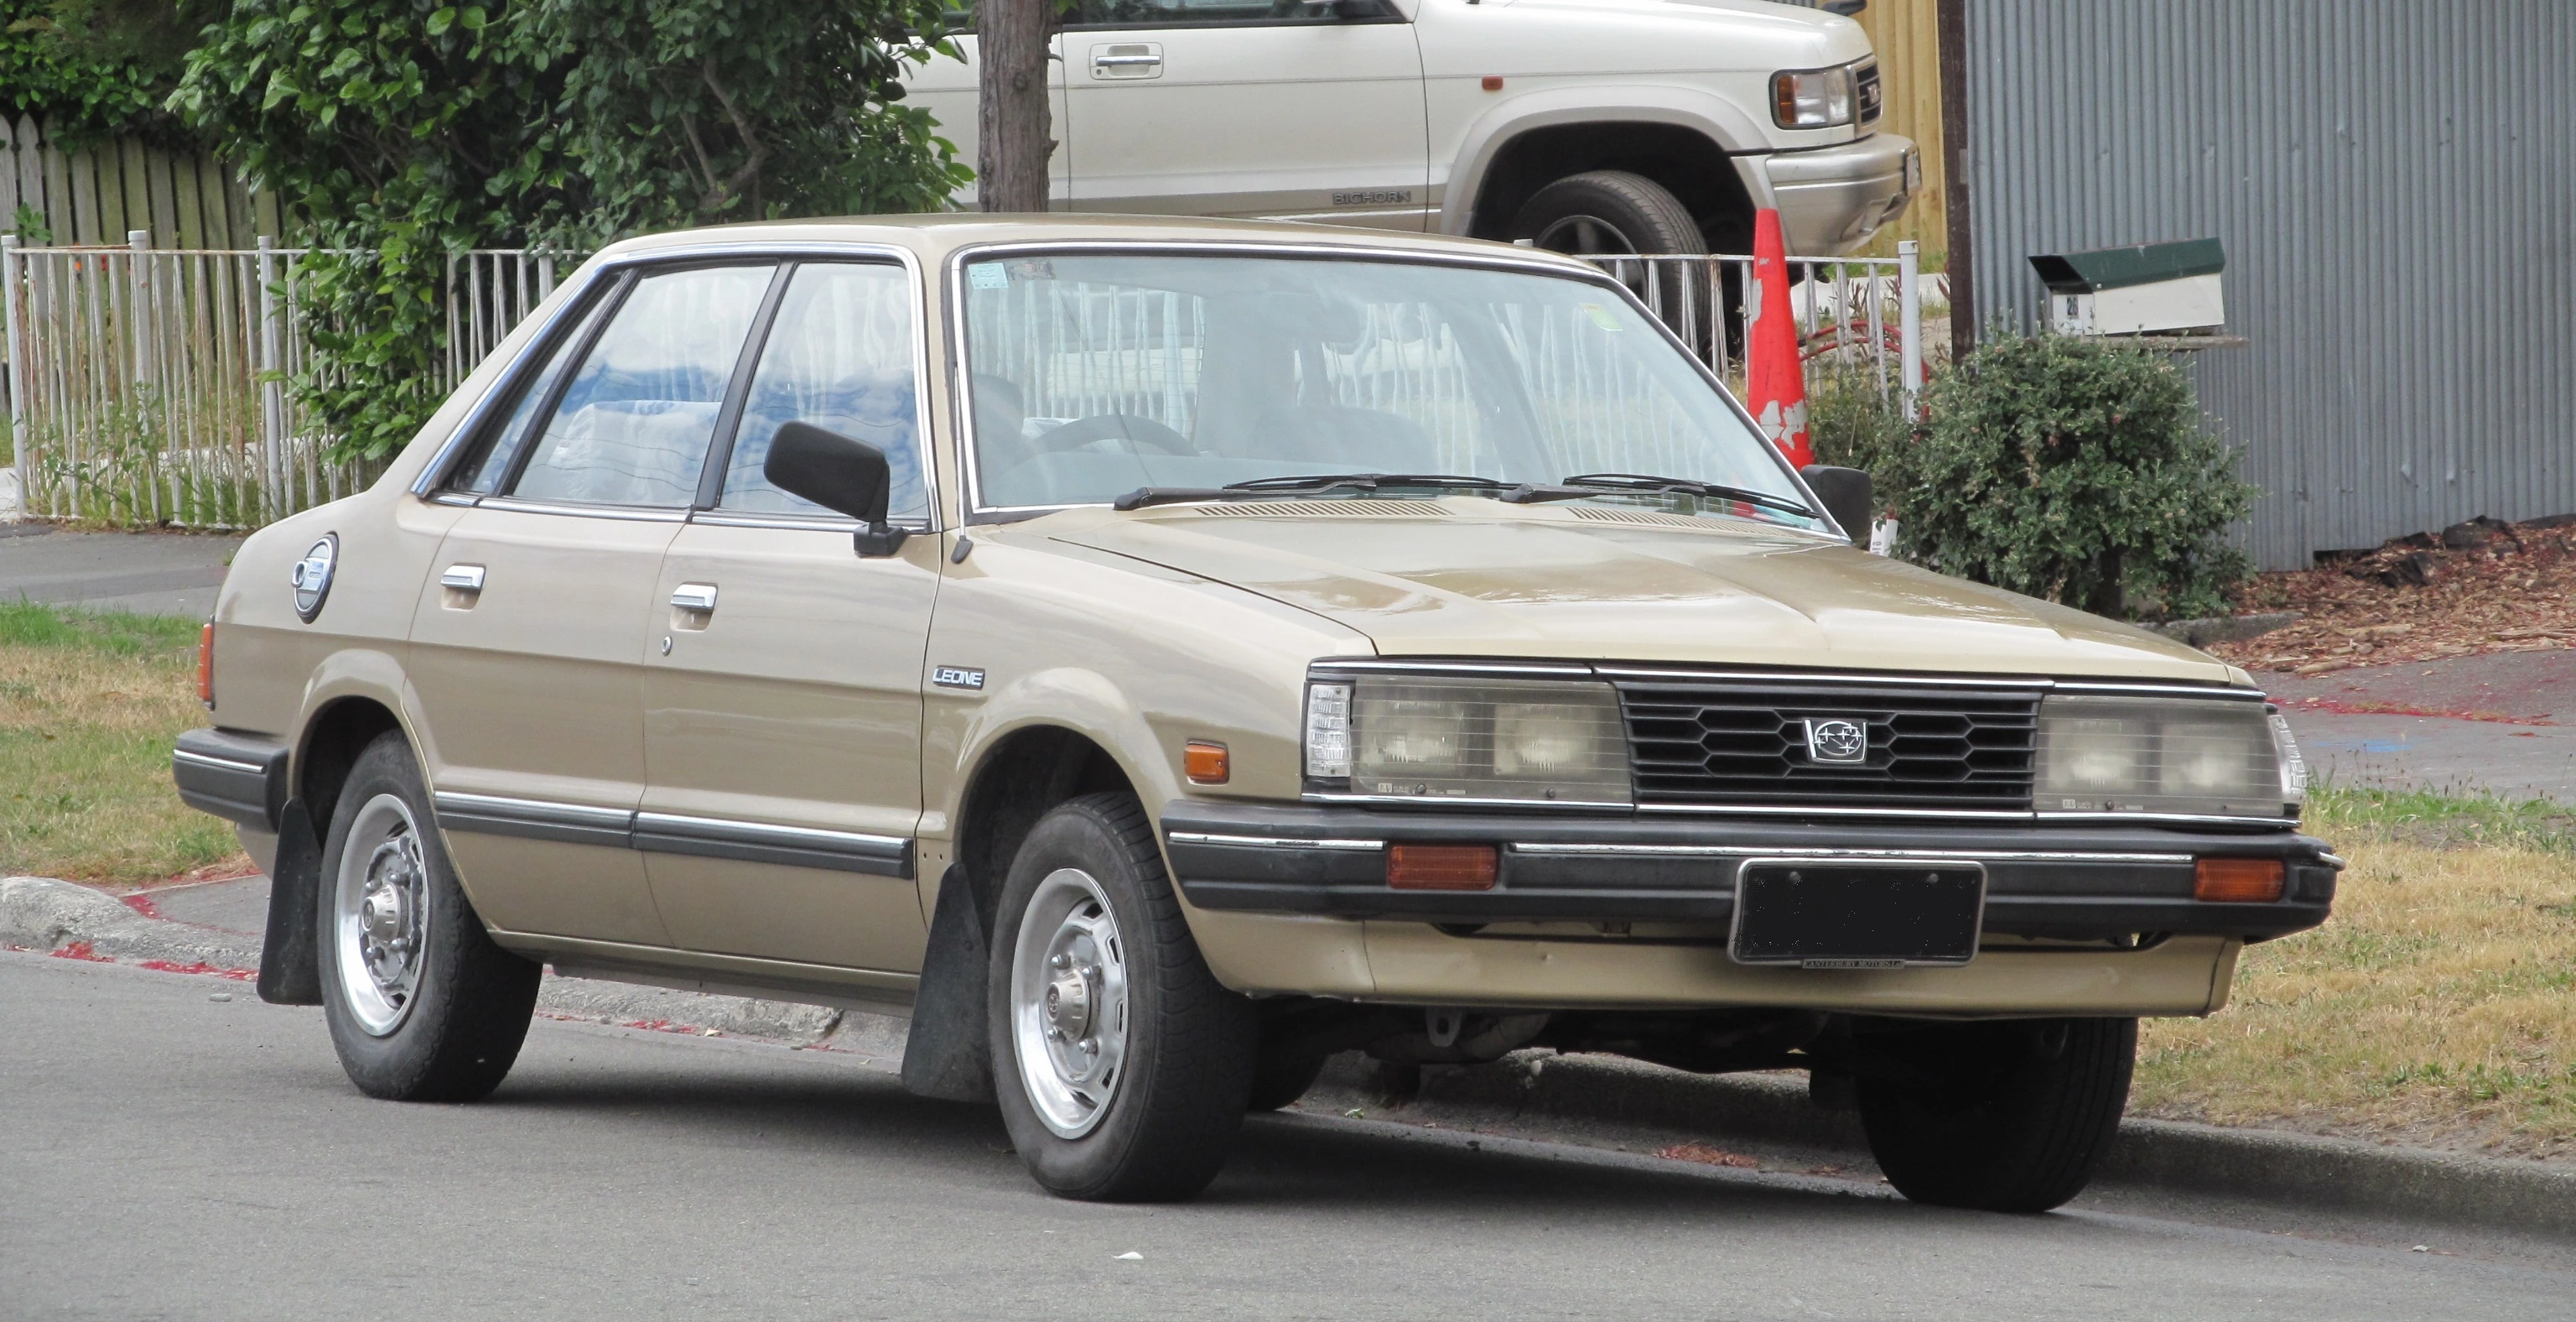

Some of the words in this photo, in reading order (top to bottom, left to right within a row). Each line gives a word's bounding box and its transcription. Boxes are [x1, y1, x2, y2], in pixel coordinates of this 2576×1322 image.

[1332, 190, 1411, 205] BIGHORN
[932, 668, 983, 686] LEONE
[1804, 960, 1856, 968] CANTERBURY
[1858, 960, 1891, 969] MOTORS
